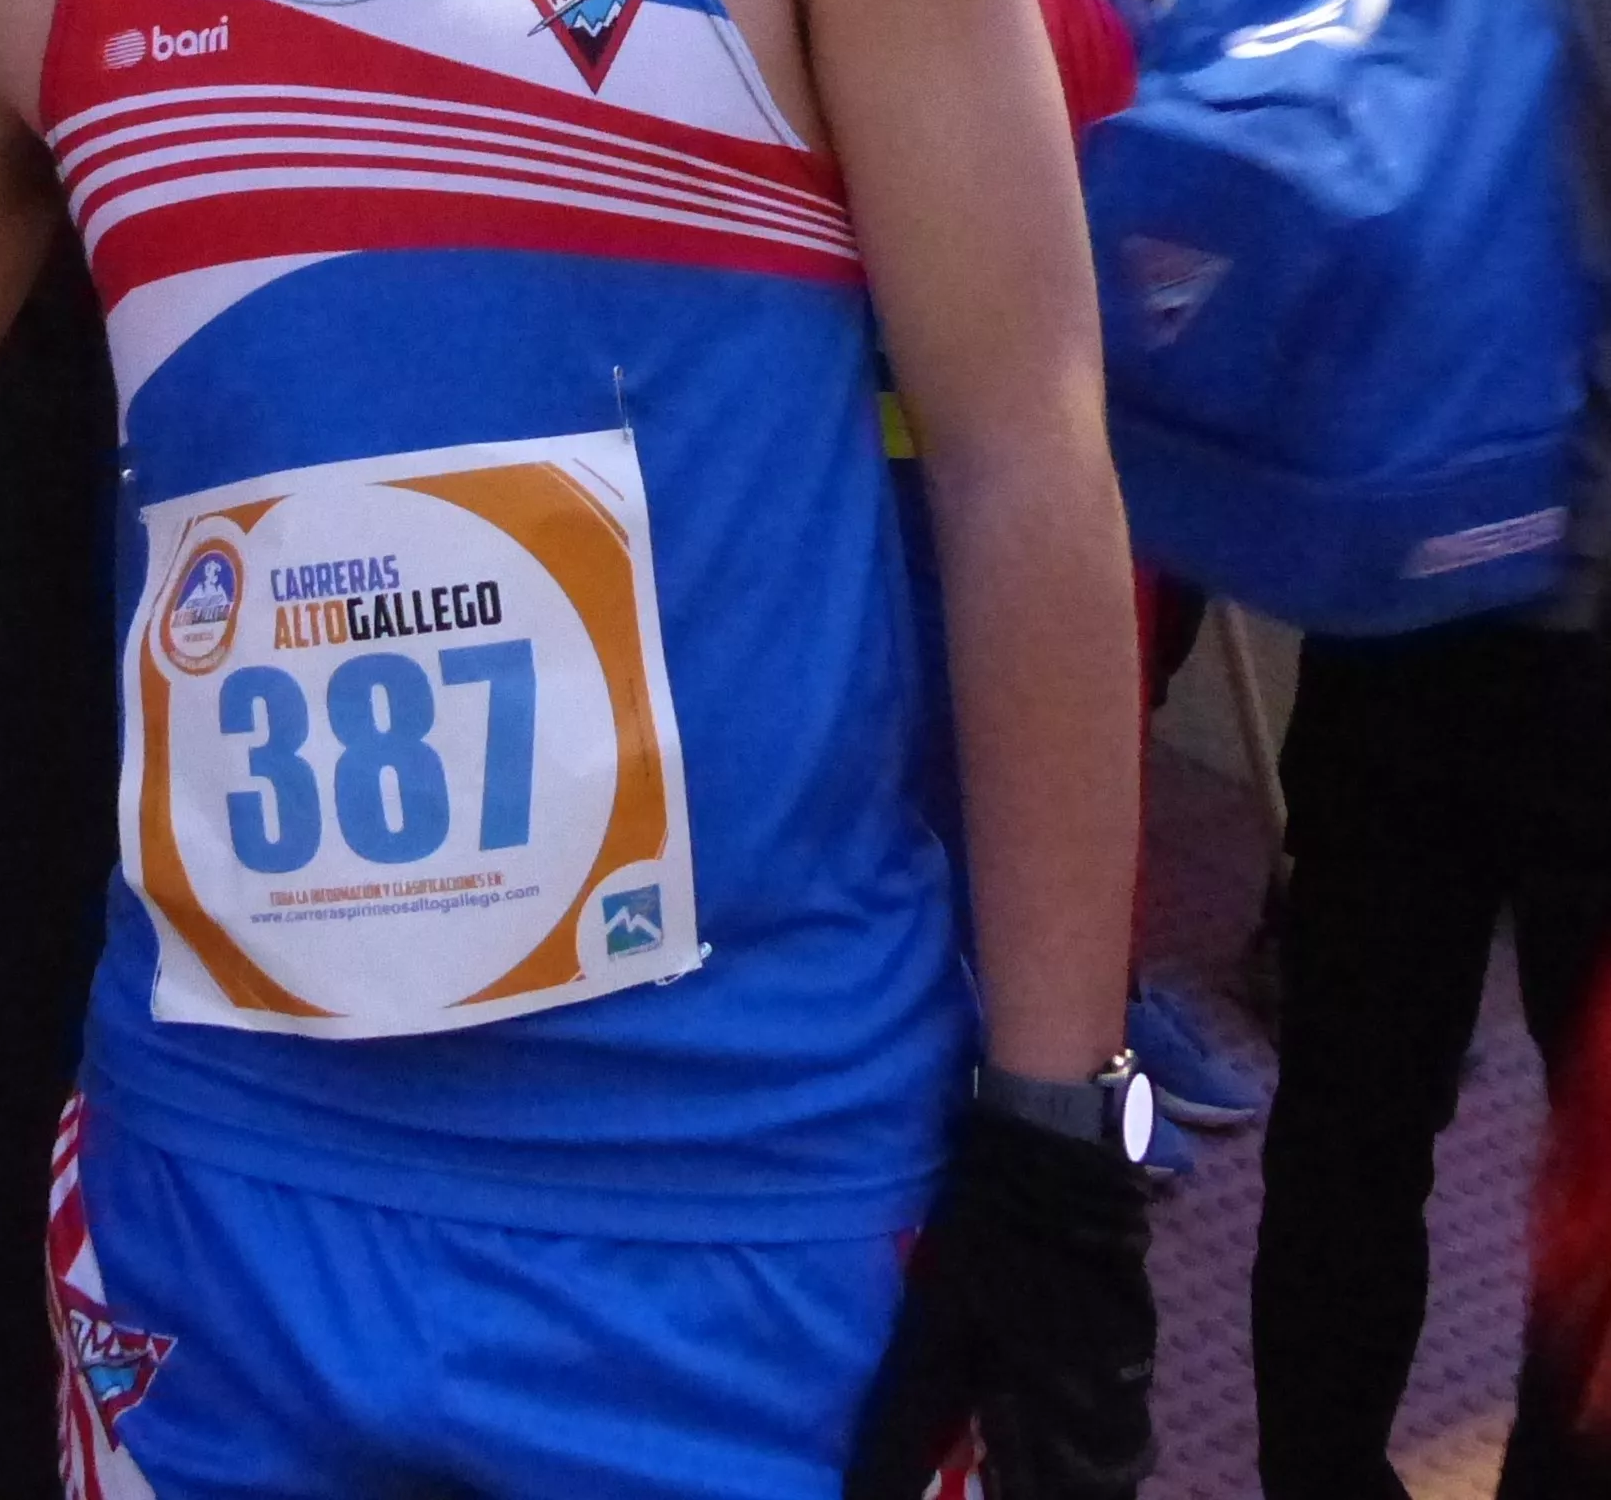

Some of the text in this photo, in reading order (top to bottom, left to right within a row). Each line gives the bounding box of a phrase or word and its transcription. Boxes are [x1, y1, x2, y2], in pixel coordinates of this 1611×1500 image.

[151, 15, 230, 61] barri
[270, 554, 400, 602] CARRERAS
[273, 579, 503, 650] ALTOGALLEGO
[218, 637, 537, 874] 387
